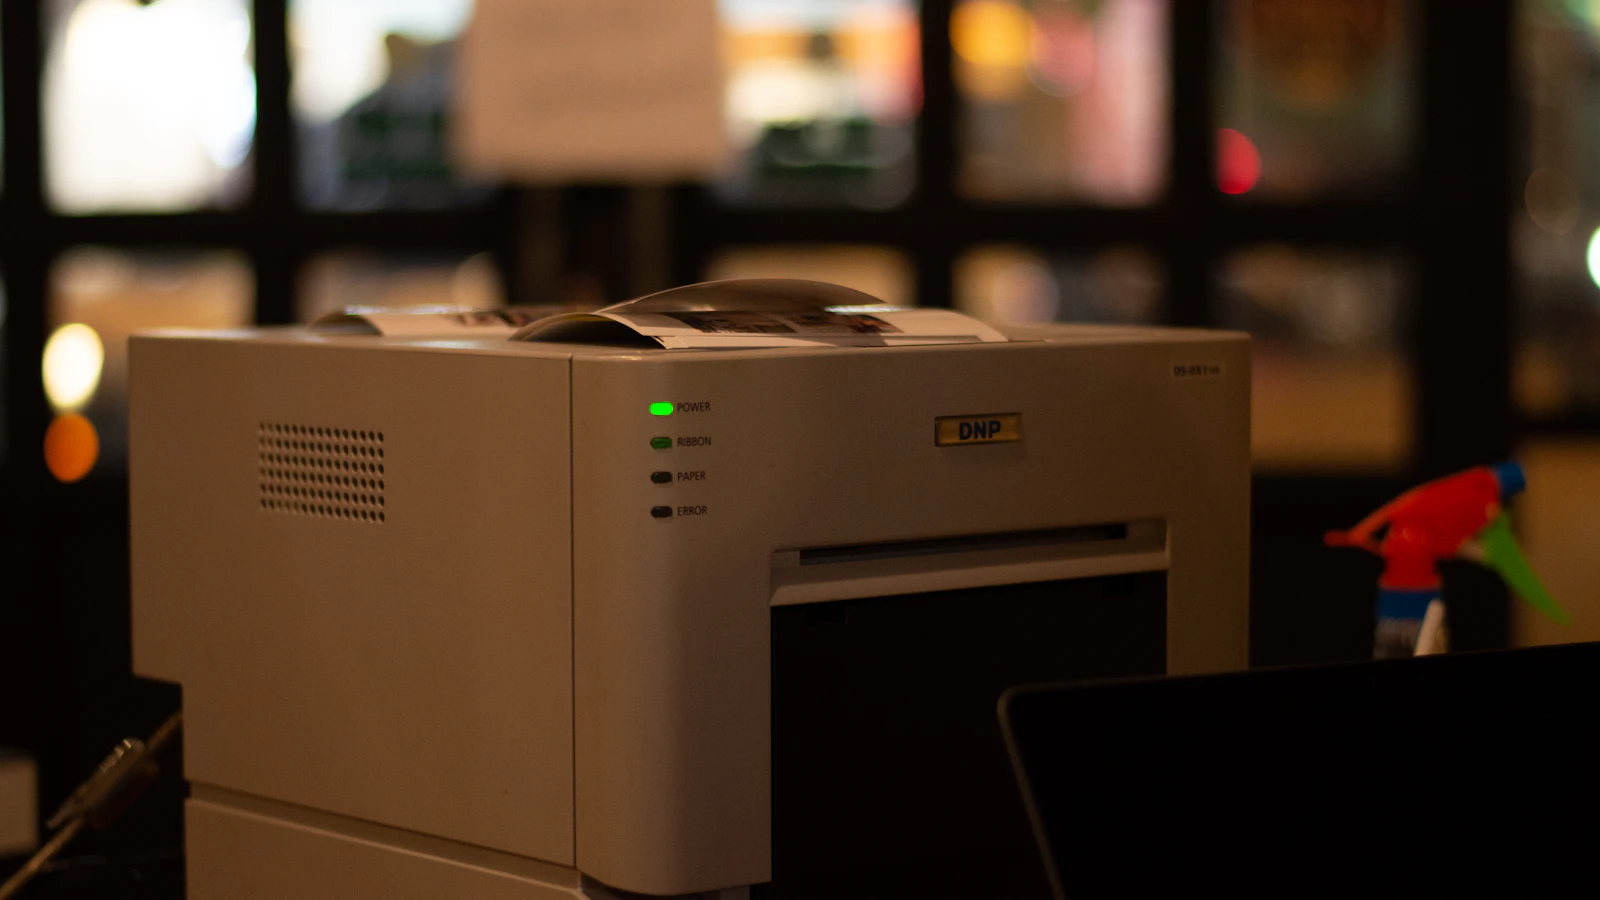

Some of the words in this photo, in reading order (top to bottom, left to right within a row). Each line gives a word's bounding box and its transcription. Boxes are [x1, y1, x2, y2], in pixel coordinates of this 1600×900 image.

[677, 401, 711, 412] POWER
[959, 420, 1002, 441] DNP
[677, 436, 712, 447] RIBBON
[677, 470, 706, 482] PAPER
[677, 505, 708, 517] ERROR
